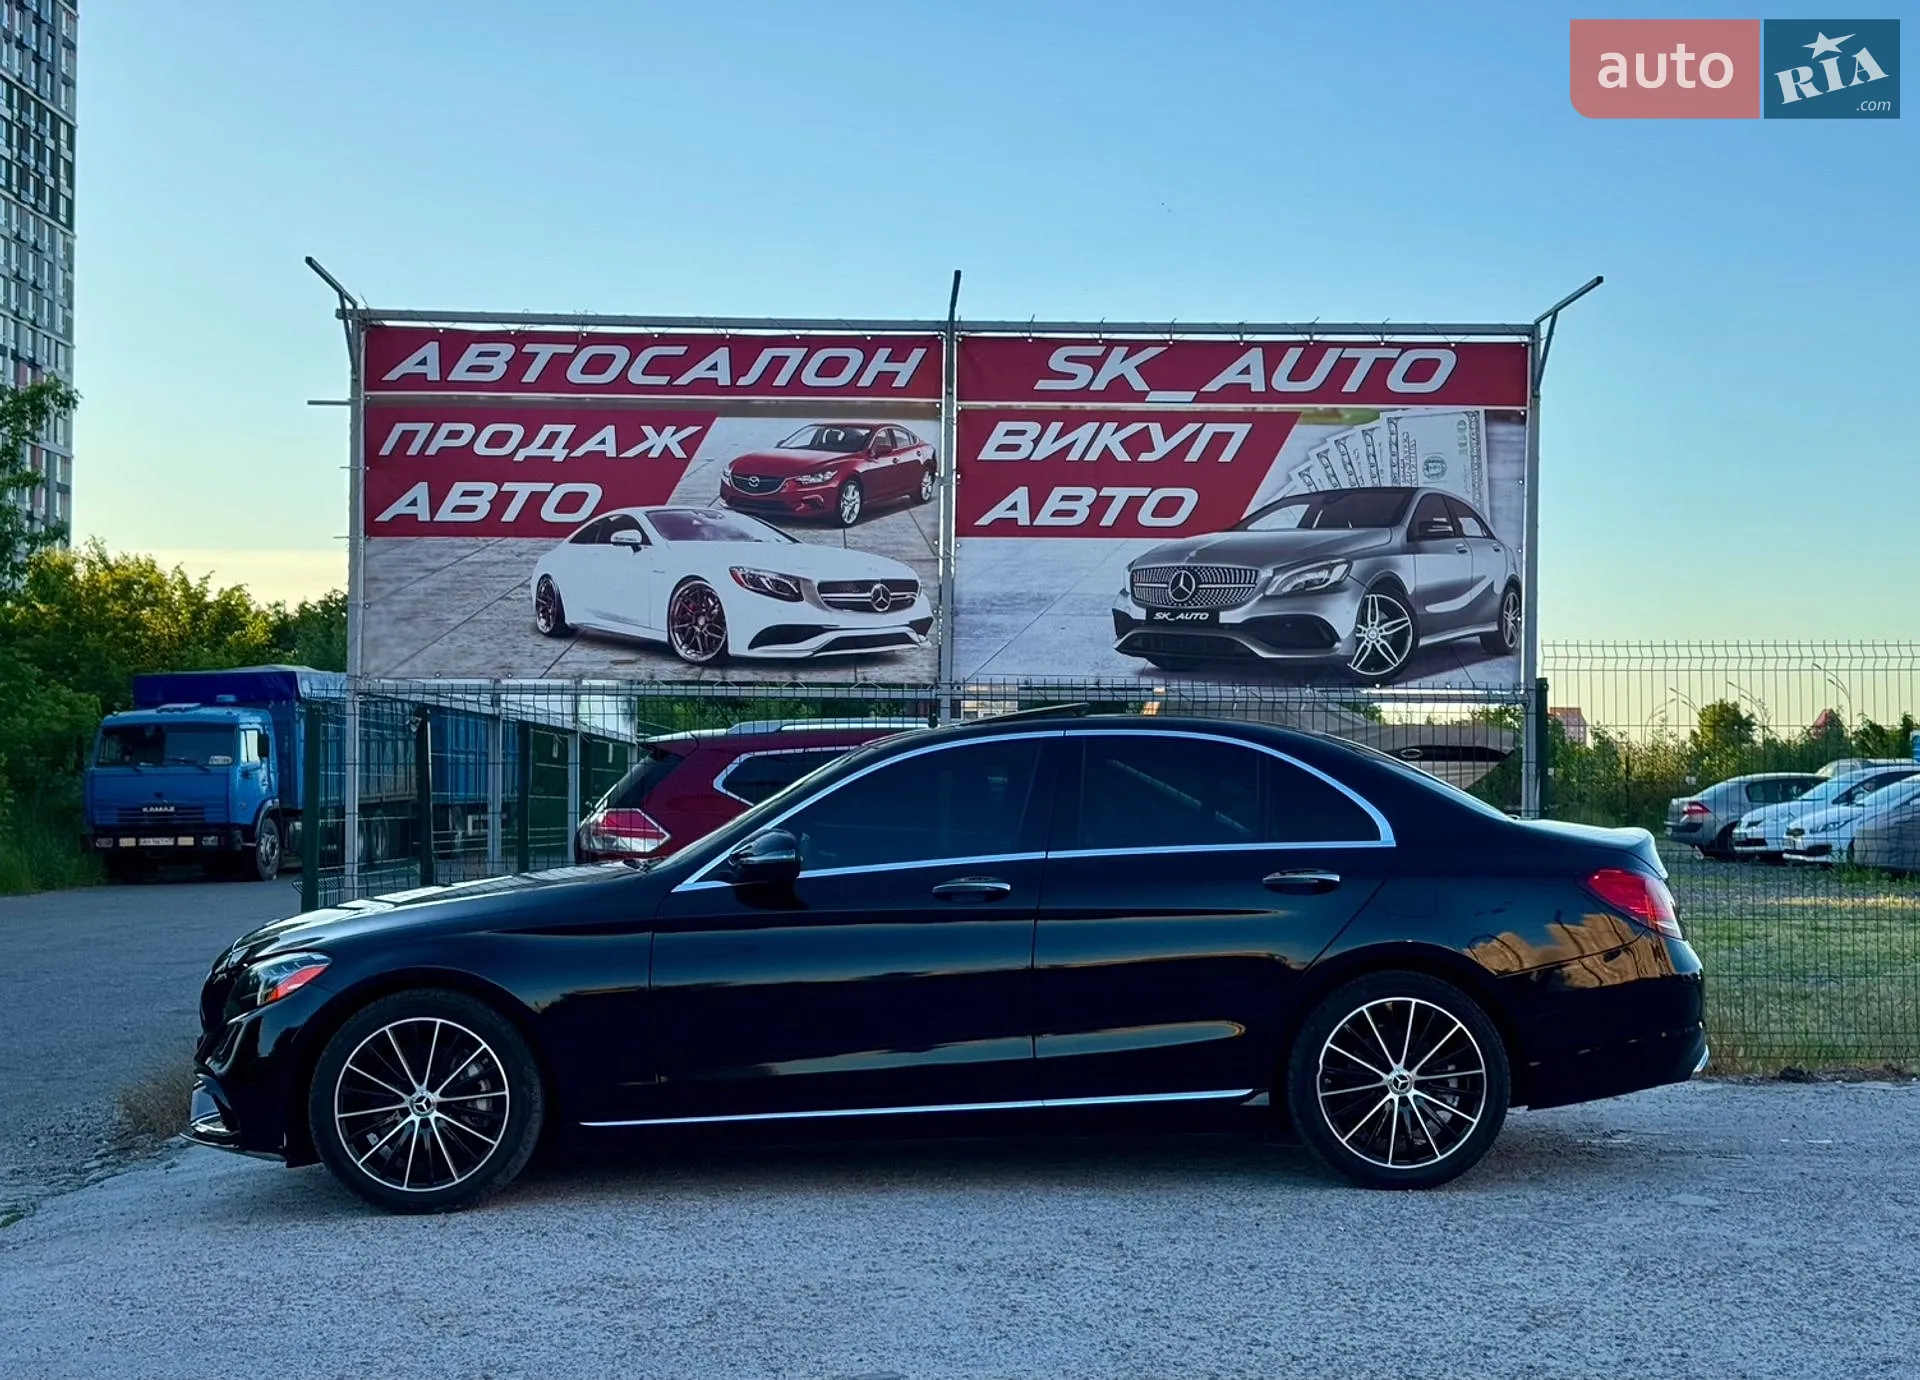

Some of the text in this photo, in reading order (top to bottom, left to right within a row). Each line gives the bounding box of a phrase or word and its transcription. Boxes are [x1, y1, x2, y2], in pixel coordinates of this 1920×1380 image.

[381, 341, 926, 387] АВТОСАЛОН
[1033, 345, 1458, 403] SK_AUTO
[379, 422, 702, 462] ПРОДАЖ
[976, 421, 1253, 463] ВИКУП
[375, 481, 602, 523] АВТО
[974, 486, 1199, 527] АВТО
[1153, 612, 1210, 621] SK_AUTO
